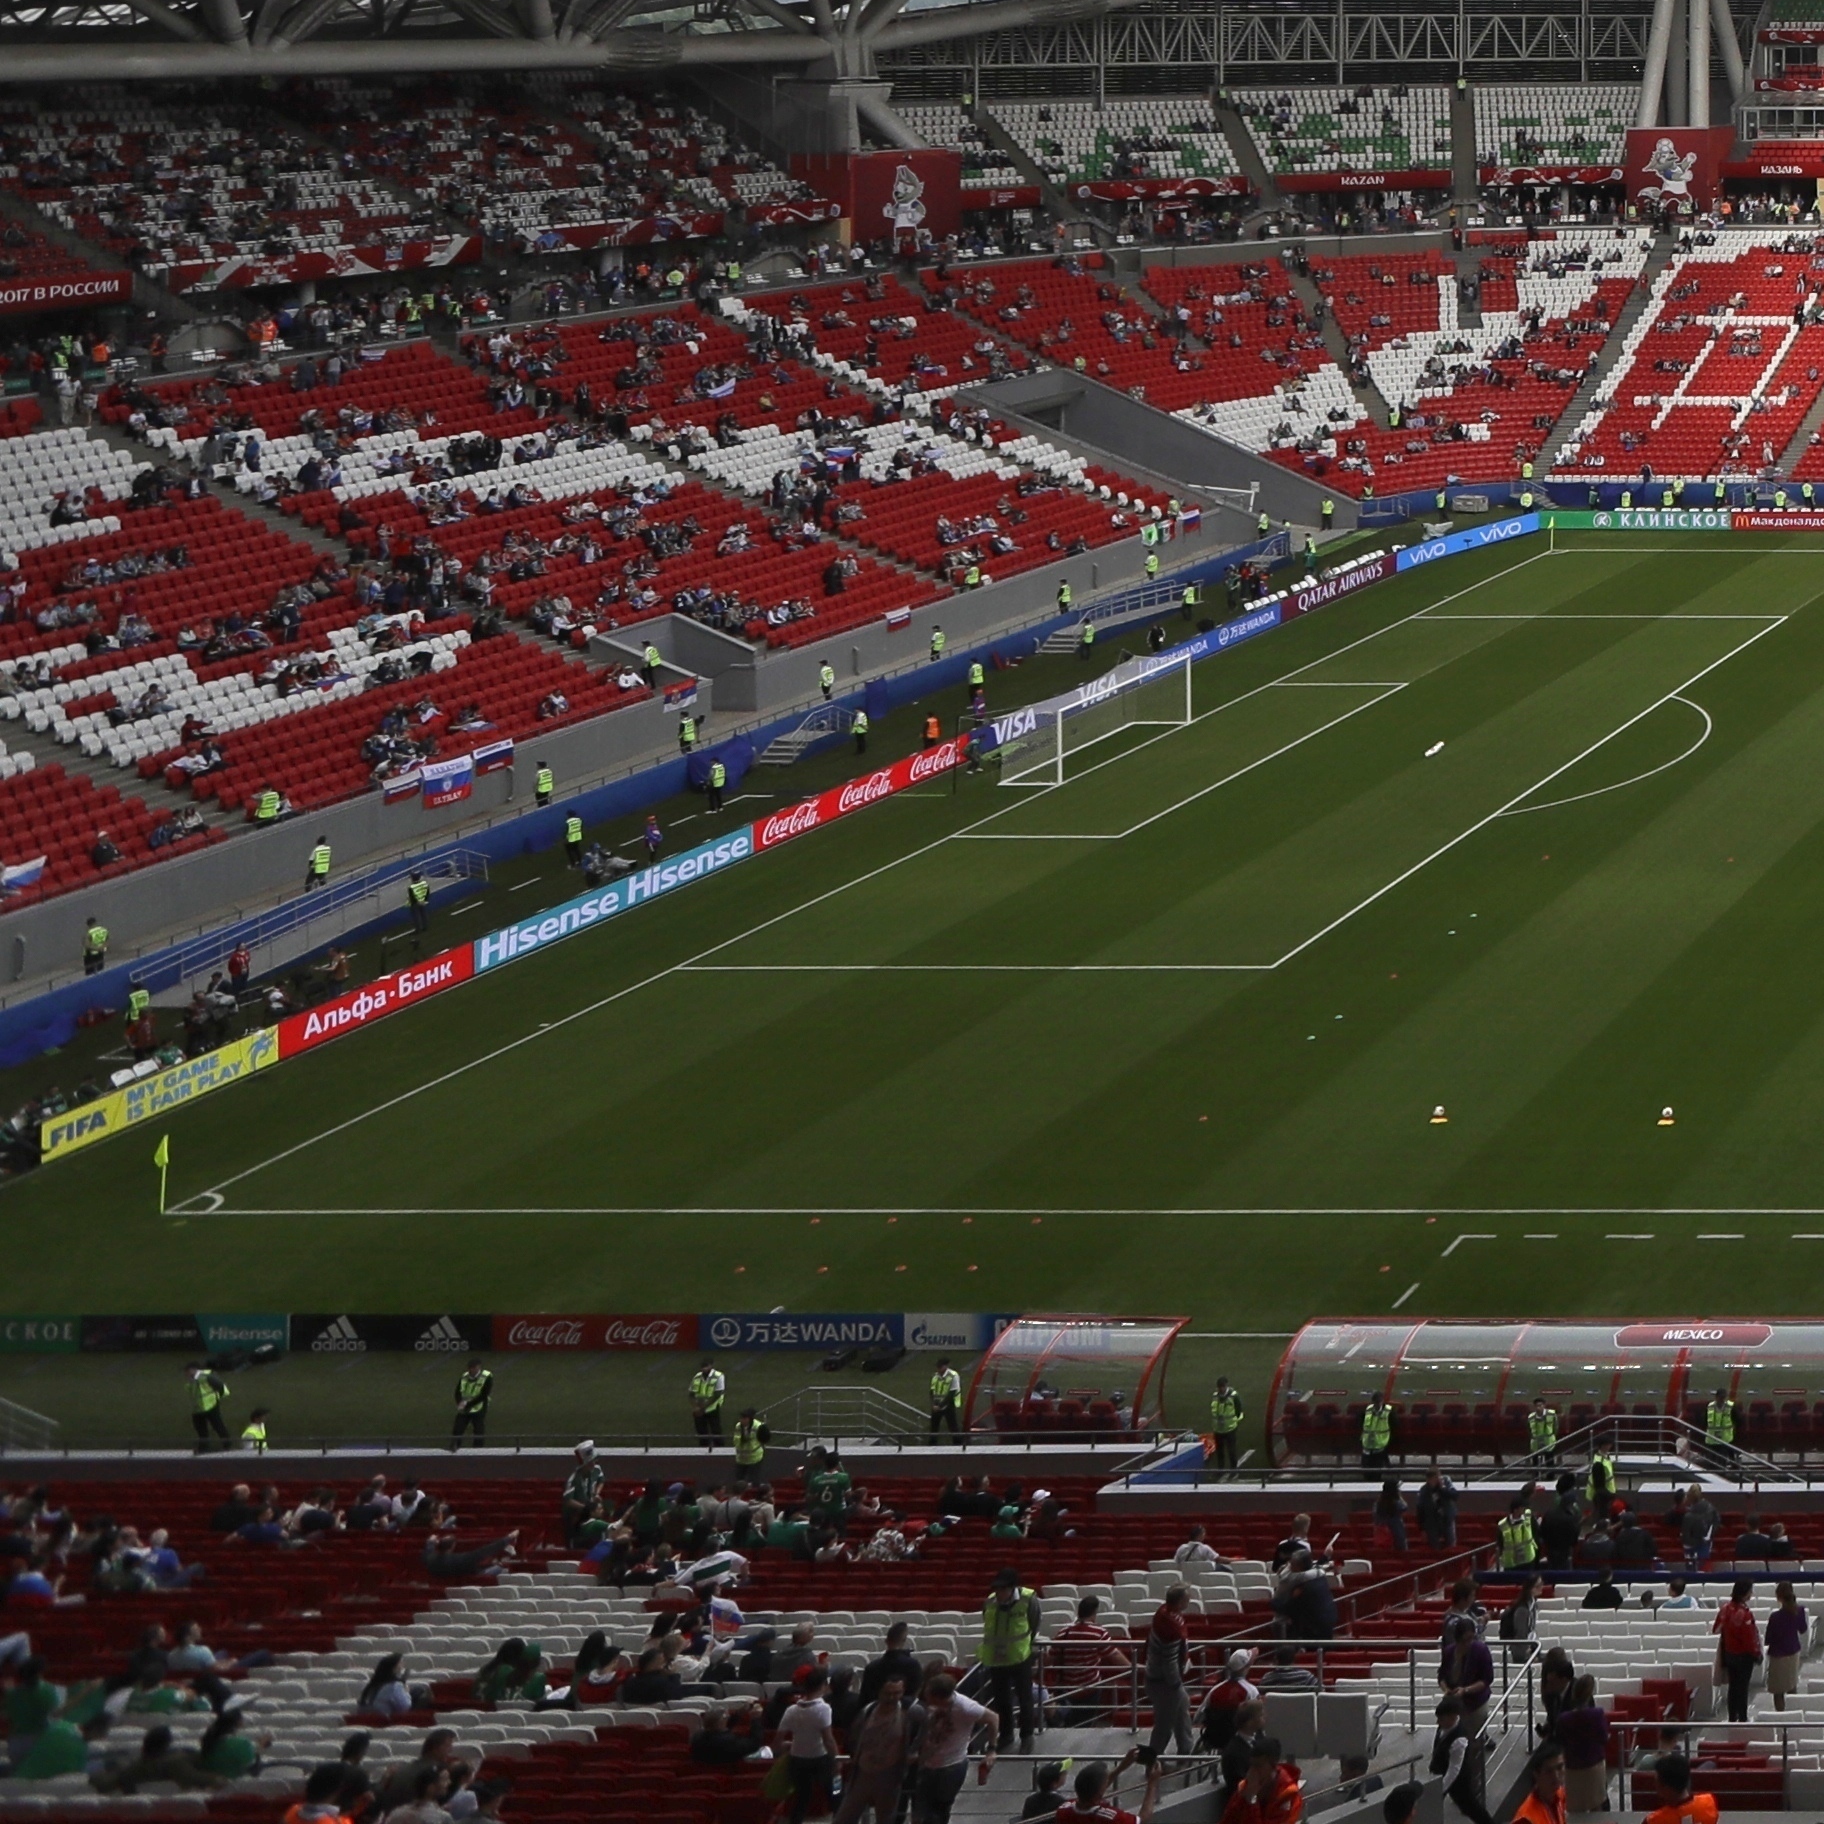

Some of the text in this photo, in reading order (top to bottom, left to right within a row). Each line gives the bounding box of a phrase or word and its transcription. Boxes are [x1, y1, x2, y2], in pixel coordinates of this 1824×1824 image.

[1761, 165, 1803, 174] КАЗАНЬ
[1341, 175, 1385, 186] KAZAN
[35, 287, 46, 300] В
[51, 280, 120, 299] РОССИИ
[1621, 515, 1730, 527] КЛИНСКОЕ
[1298, 561, 1383, 612] QATAR AIRWAYS
[1077, 673, 1118, 708] VISA
[990, 708, 1036, 745] VISA
[480, 836, 749, 968] Hisense Hisense
[126, 1055, 219, 1106] MY GAME
[127, 1061, 243, 1122] IS FAIR PLAY
[50, 1110, 107, 1147] FIFA
[209, 1326, 283, 1342] Hisense
[1662, 1329, 1724, 1340] MEXICO
[312, 1337, 470, 1352] adidas adidas
[821, 1485, 833, 1502] 6
